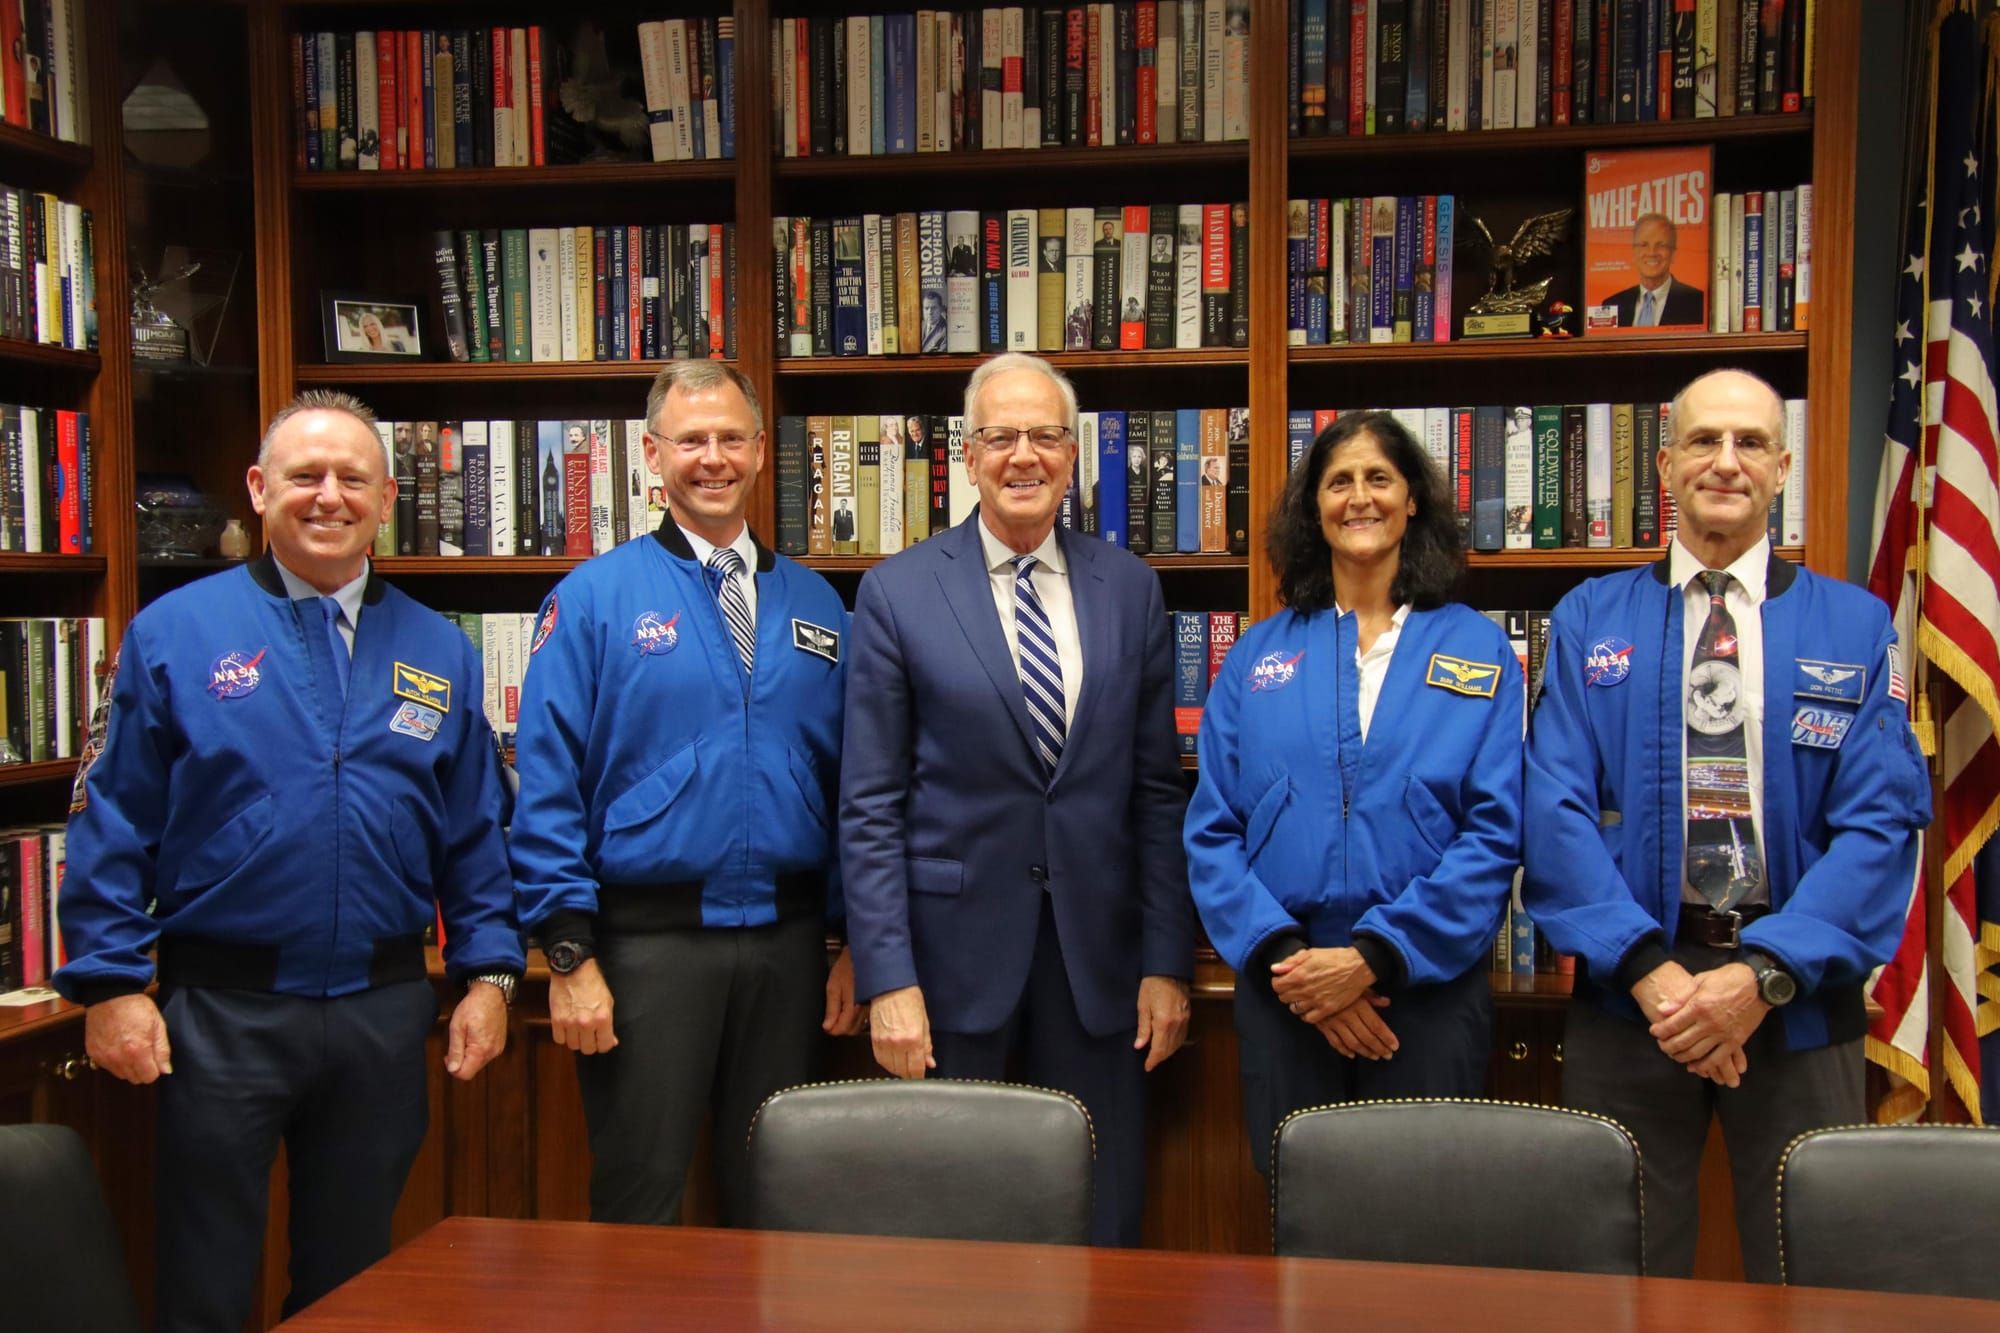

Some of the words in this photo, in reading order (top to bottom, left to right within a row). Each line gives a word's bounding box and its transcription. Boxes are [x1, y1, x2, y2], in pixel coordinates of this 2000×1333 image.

[1089, 17, 1097, 32] RED
[1138, 8, 1146, 43] RISING
[1208, 12, 1219, 32] Bill
[1523, 1, 1533, 31] DESK
[1749, 1, 1758, 27] High
[1067, 9, 1082, 69] CHENEY
[1089, 36, 1097, 59] STATE
[1355, 20, 1363, 55] AGENDA
[1392, 24, 1401, 62] NIXON
[1524, 35, 1534, 47] 88
[1703, 26, 1711, 43] Year
[1748, 29, 1757, 63] Crimes
[455, 38, 463, 72] REGAN
[857, 25, 866, 80] KENNEDY
[1089, 60, 1098, 97] UPRISING
[1208, 49, 1220, 89] Hillary
[1678, 66, 1689, 75] of
[1354, 75, 1363, 114] AMERICA
[1674, 79, 1692, 88] Oil
[1590, 171, 1704, 228] WHEATIES
[7, 192, 21, 270] IMPEACHED
[712, 234, 720, 248] THE
[986, 219, 1000, 242] OUR
[1012, 217, 1029, 267] CHAIRMAN
[1438, 202, 1449, 272] GENESIS
[1749, 231, 1758, 251] ROAD
[630, 229, 638, 268] REVIVING
[920, 216, 932, 276] NIXON
[933, 215, 942, 275] RICHARD
[986, 243, 1000, 269] MAN
[1210, 210, 1224, 282] WASHINGTON
[578, 235, 588, 293] INFIDEL
[712, 251, 720, 278] PICNIC
[823, 254, 828, 265] OF
[842, 268, 853, 276] THE
[836, 277, 862, 286] AMBITION
[839, 287, 848, 295] AND
[849, 287, 859, 295] THE
[1076, 259, 1084, 299] DIPLOMACY
[1181, 251, 1197, 325] KENNAN
[1748, 259, 1758, 303] PROSPERITY
[777, 302, 784, 311] AT
[839, 296, 859, 305] POWER
[989, 282, 999, 310] GEORGE
[473, 310, 481, 348] BOOKSHOP
[990, 313, 1000, 343] PACKER
[1459, 413, 1471, 470] WASHINGTON
[1577, 425, 1582, 433] IN
[9, 432, 17, 493] McKINLEY
[599, 446, 607, 457] THE
[833, 431, 851, 493] REAGAN
[934, 449, 945, 460] THE
[1615, 413, 1629, 484] OBAMA
[599, 458, 607, 473] LAST
[933, 465, 946, 476] VERY
[1546, 429, 1558, 508] GOLDWATER
[813, 438, 824, 524] REAGAN
[1459, 473, 1471, 512] JOURNAL
[494, 465, 506, 536] REAGAN
[574, 460, 587, 533] EINSTEIN
[568, 494, 576, 534] ISAACSON
[600, 506, 608, 528] JAMES
[486, 622, 496, 636] Bob
[637, 625, 678, 639] NASA
[1179, 625, 1202, 633] LAST
[1182, 616, 1200, 624] THE
[1211, 625, 1235, 633] LAST
[1213, 616, 1232, 624] THE
[1179, 634, 1202, 642] LION
[1211, 634, 1234, 642] LION
[486, 639, 496, 678] Woodward
[1255, 663, 1294, 676] NASA
[1587, 655, 1630, 667] NASA
[214, 666, 260, 683] NASA
